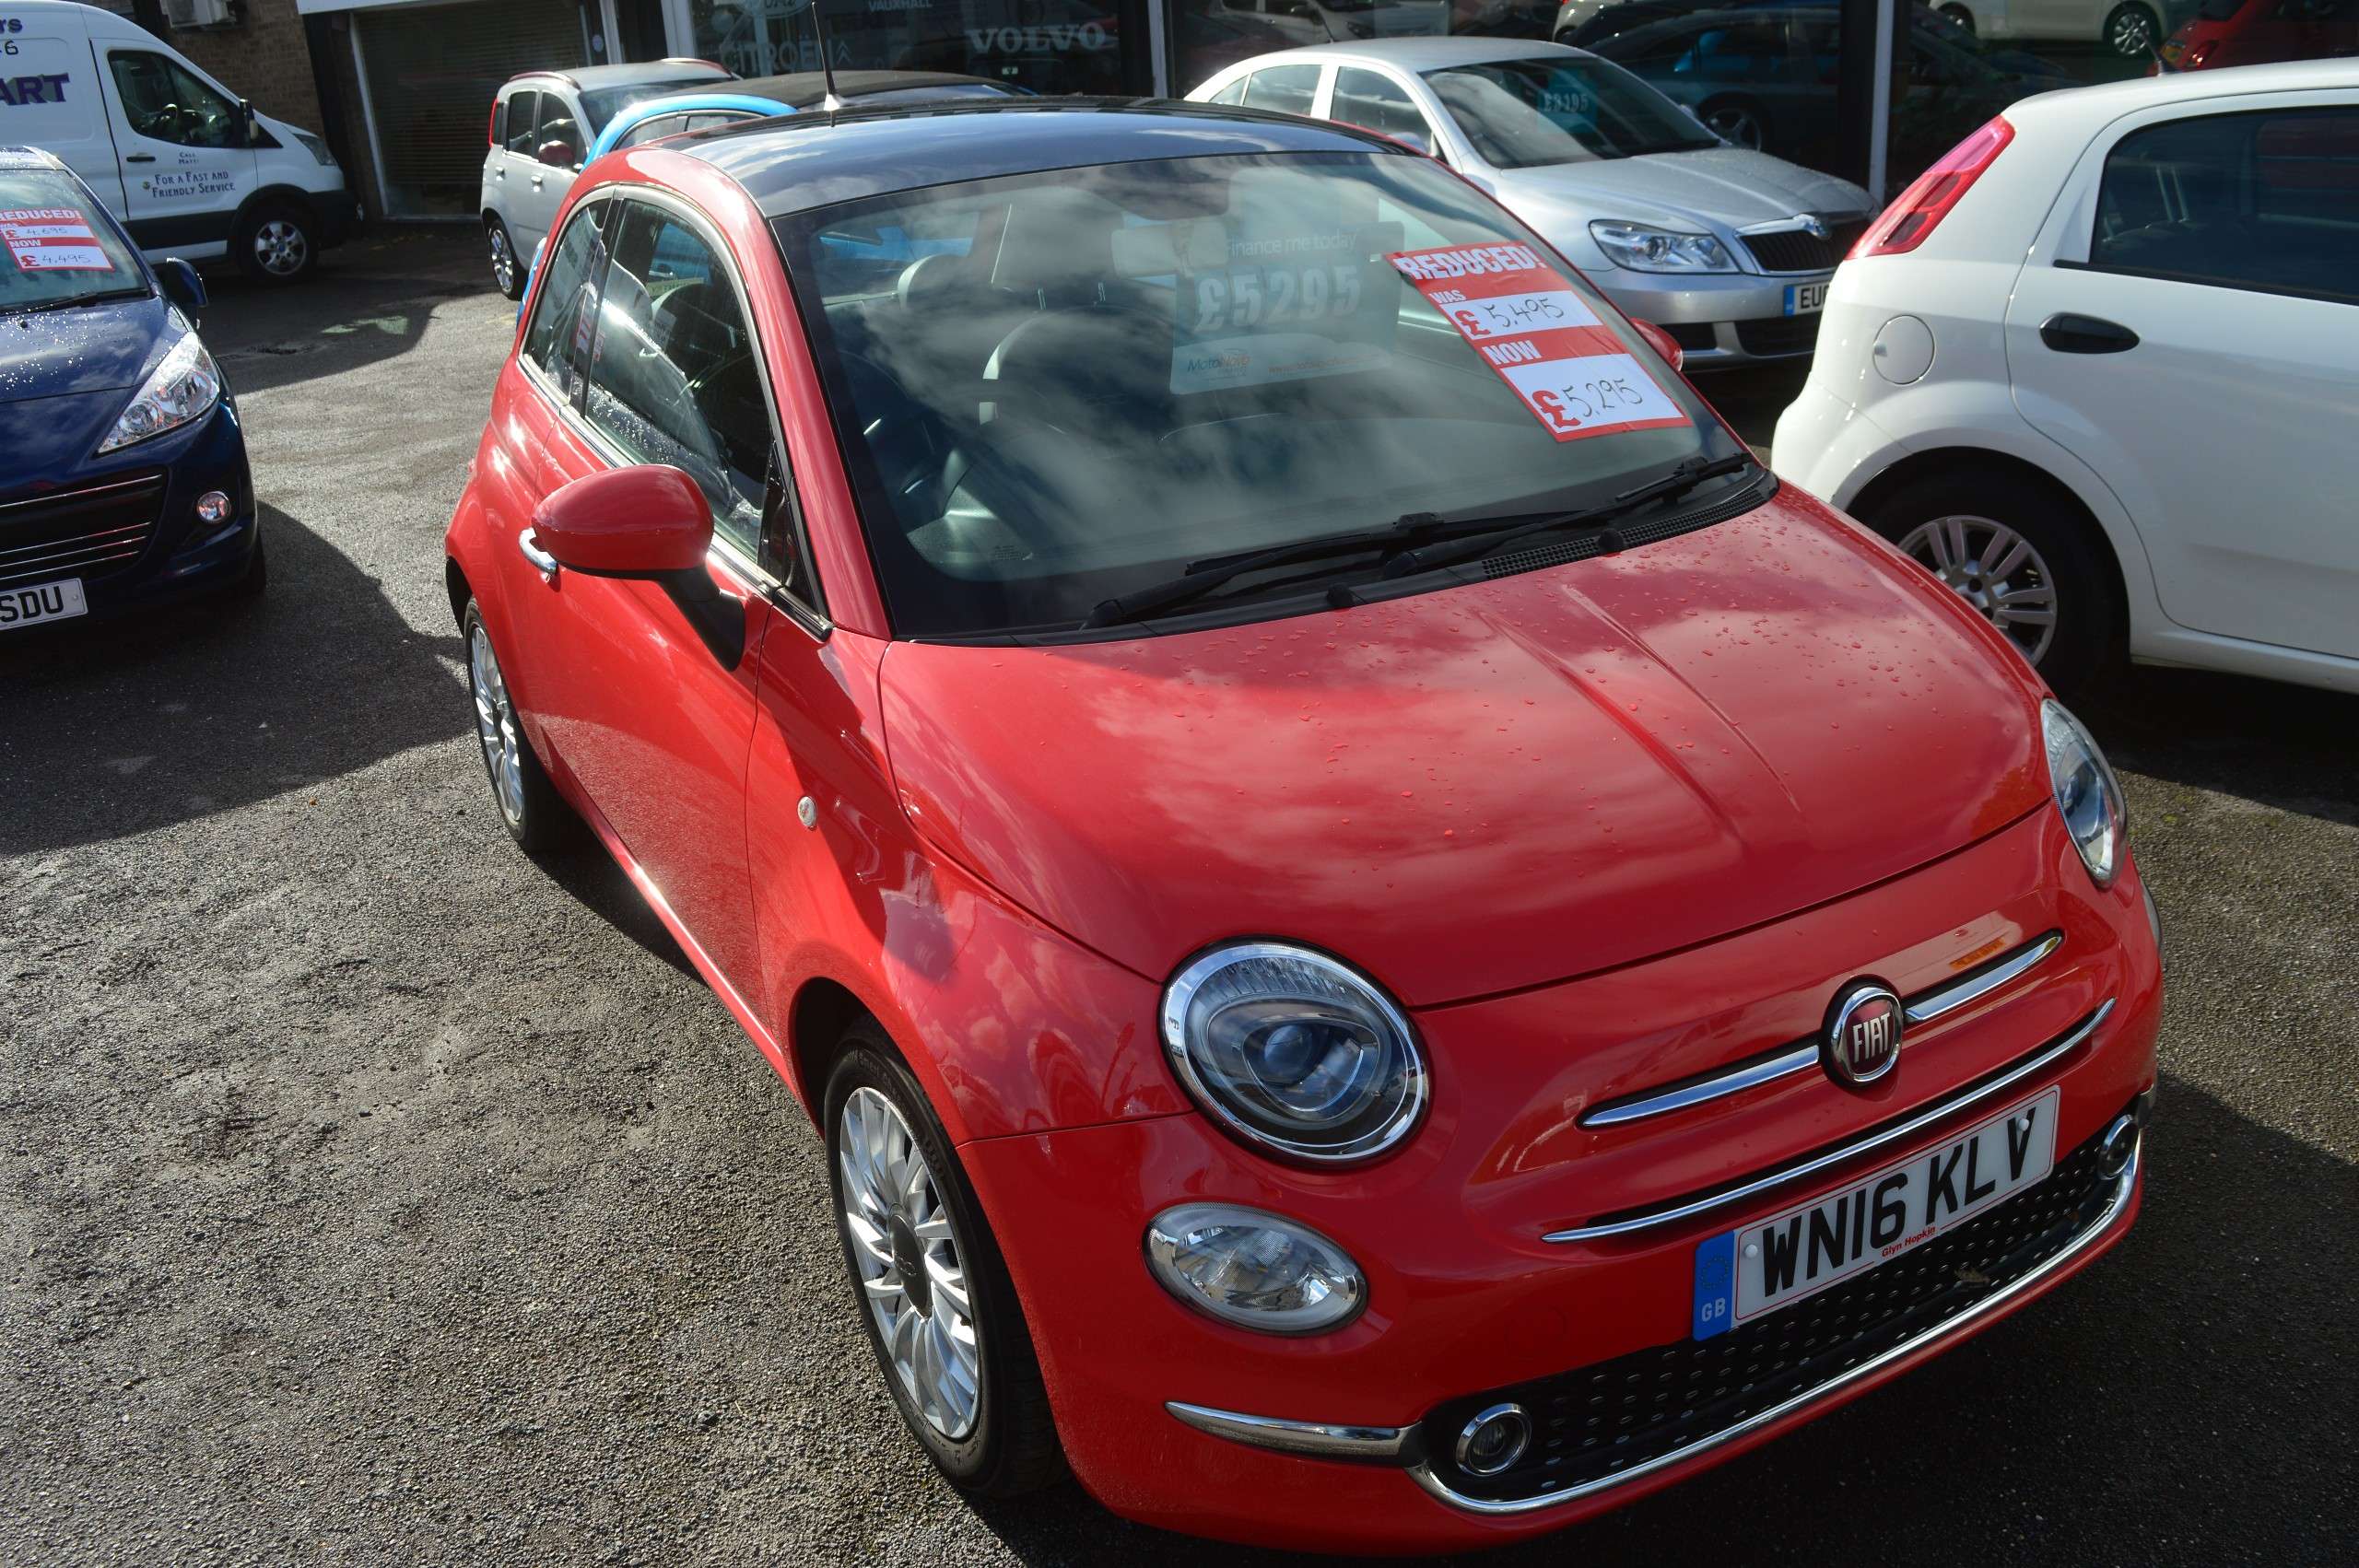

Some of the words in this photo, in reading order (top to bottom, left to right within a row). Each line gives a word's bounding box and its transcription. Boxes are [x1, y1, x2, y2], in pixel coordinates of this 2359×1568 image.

[964, 22, 1106, 54] VOLVO
[9, 240, 41, 248] NOW
[1284, 240, 1310, 253] me
[1312, 229, 1357, 252] today
[1392, 245, 1548, 281] REDUCED!
[1194, 264, 1361, 333] £5295
[1429, 289, 1467, 304] WAS
[1481, 339, 1543, 366] NOW
[1853, 1012, 1891, 1064] FIAT
[1762, 1172, 1908, 1297] WN16
[1881, 1244, 1903, 1258] Glyn
[1701, 1297, 1726, 1323] GB
